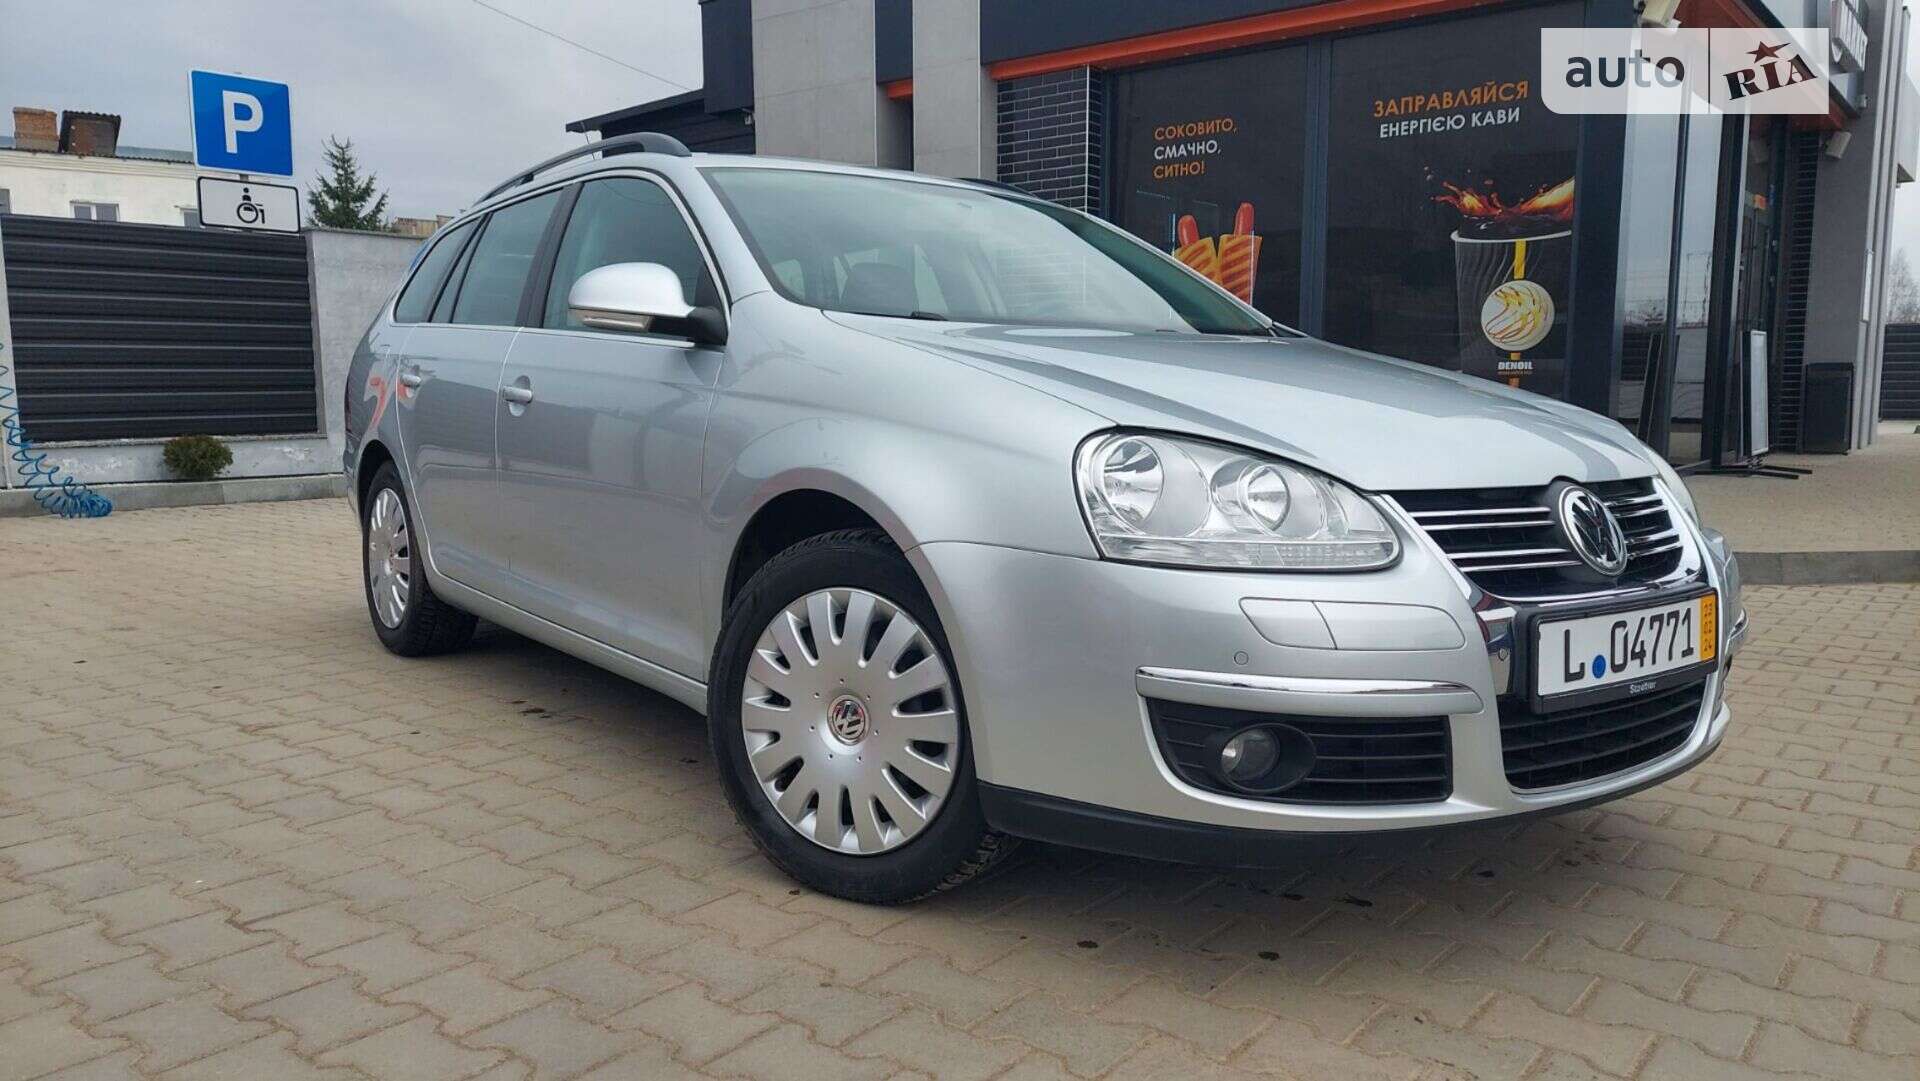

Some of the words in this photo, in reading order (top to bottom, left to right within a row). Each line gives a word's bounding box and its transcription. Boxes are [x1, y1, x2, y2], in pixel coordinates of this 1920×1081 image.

[1374, 80, 1529, 118] ЗАПРАВЛЯЙСЯ
[222, 90, 264, 154] P
[1154, 118, 1237, 140] СОКОВИТО,
[1380, 114, 1466, 138] ЕНЕРГІЄЮ
[1471, 107, 1520, 127] КАВИ
[1154, 140, 1221, 160] СМАЧНО,
[1153, 161, 1205, 179] СИТНО!
